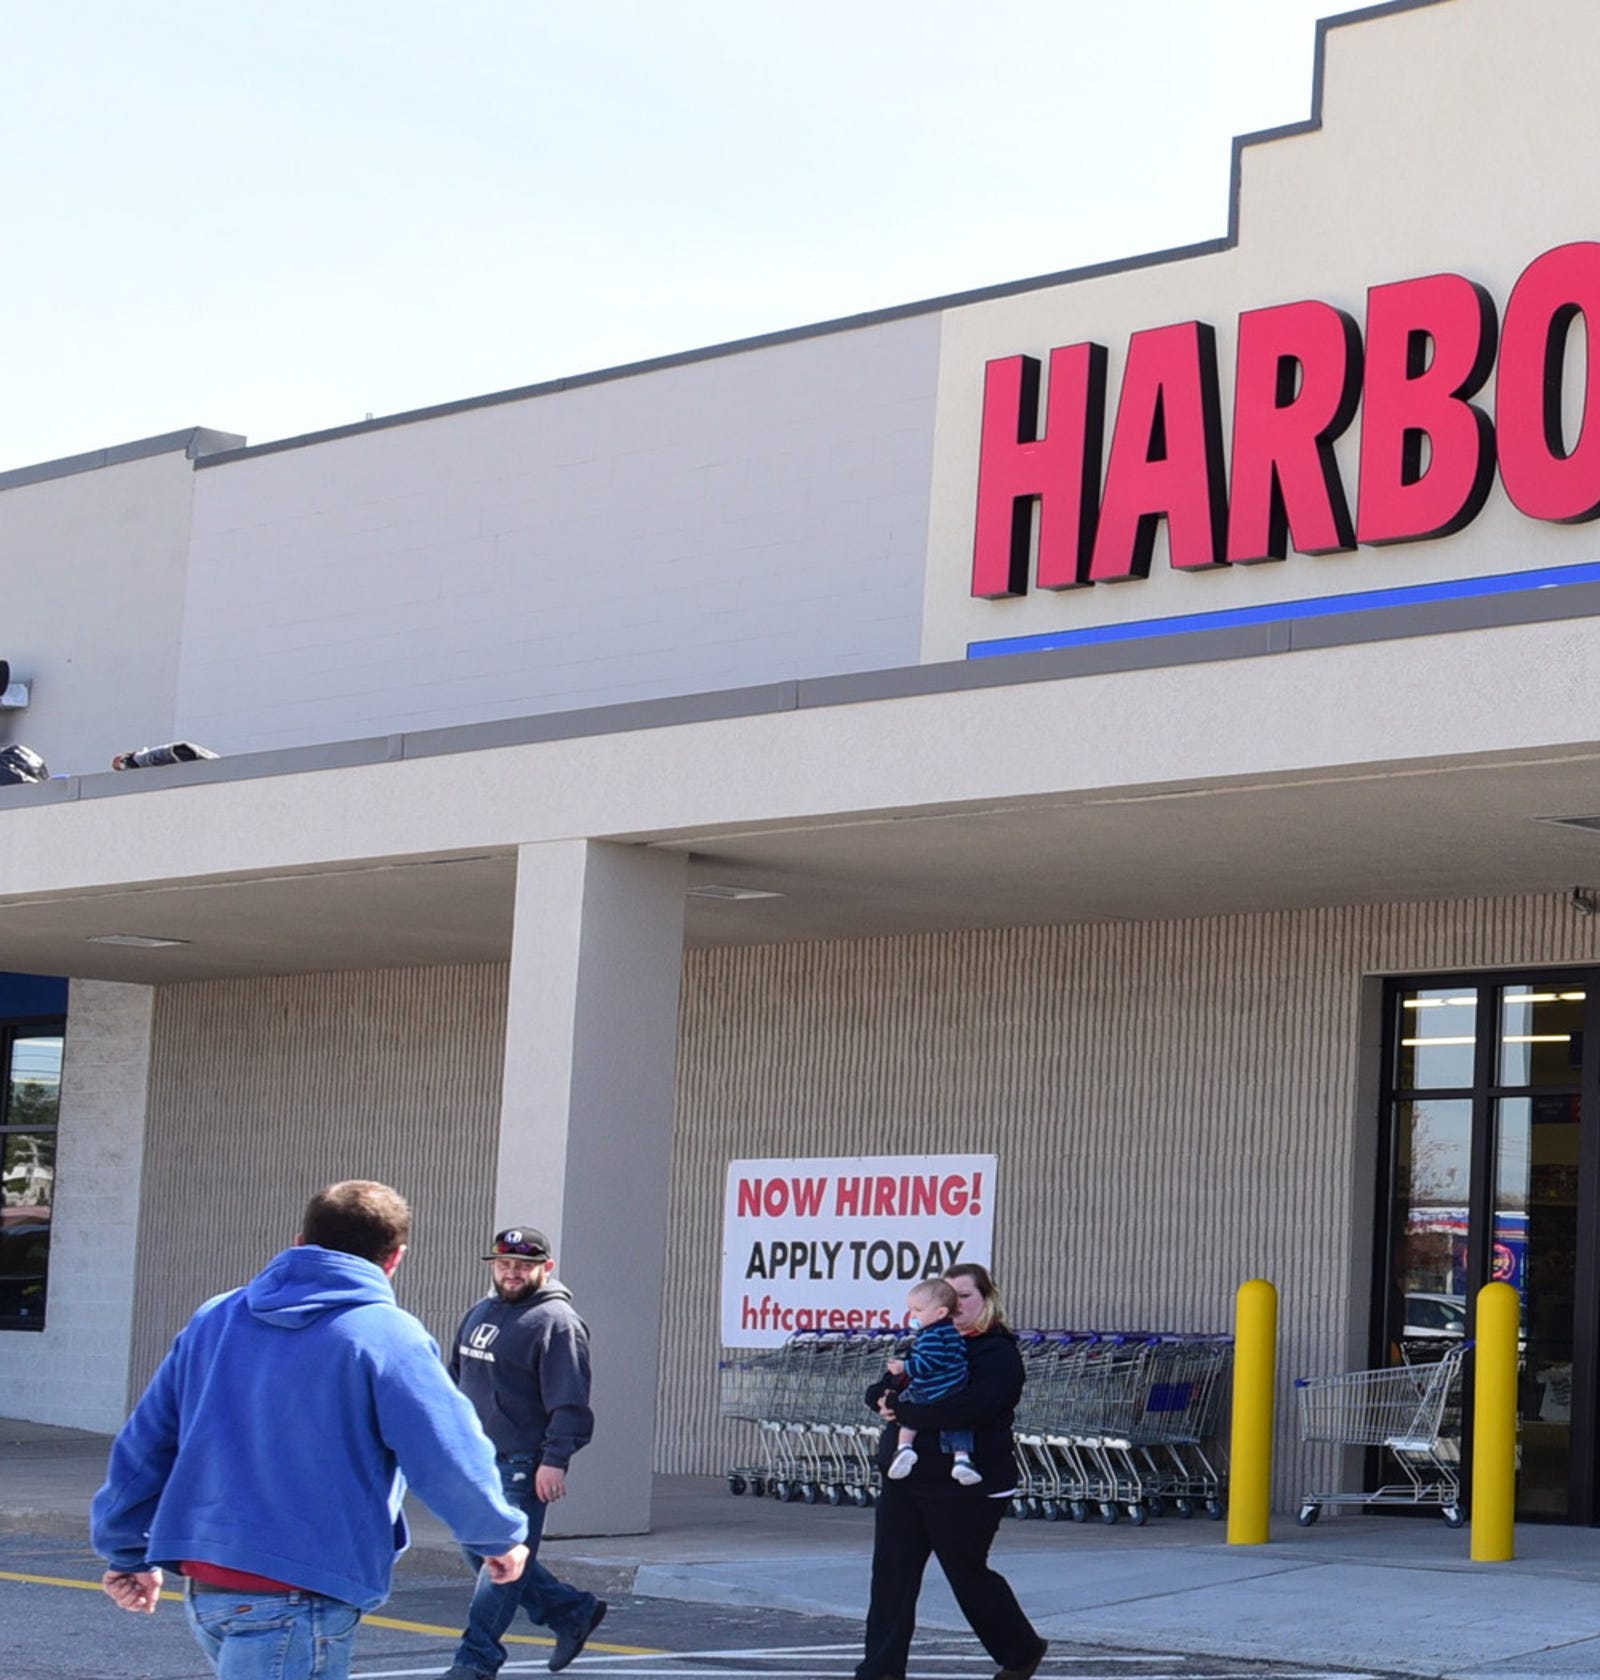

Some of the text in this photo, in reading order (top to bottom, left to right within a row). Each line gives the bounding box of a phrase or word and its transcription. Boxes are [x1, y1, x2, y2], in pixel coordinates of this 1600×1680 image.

[737, 1172, 983, 1217] NOW HIRING!
[745, 1239, 965, 1281] APPLY TODAY
